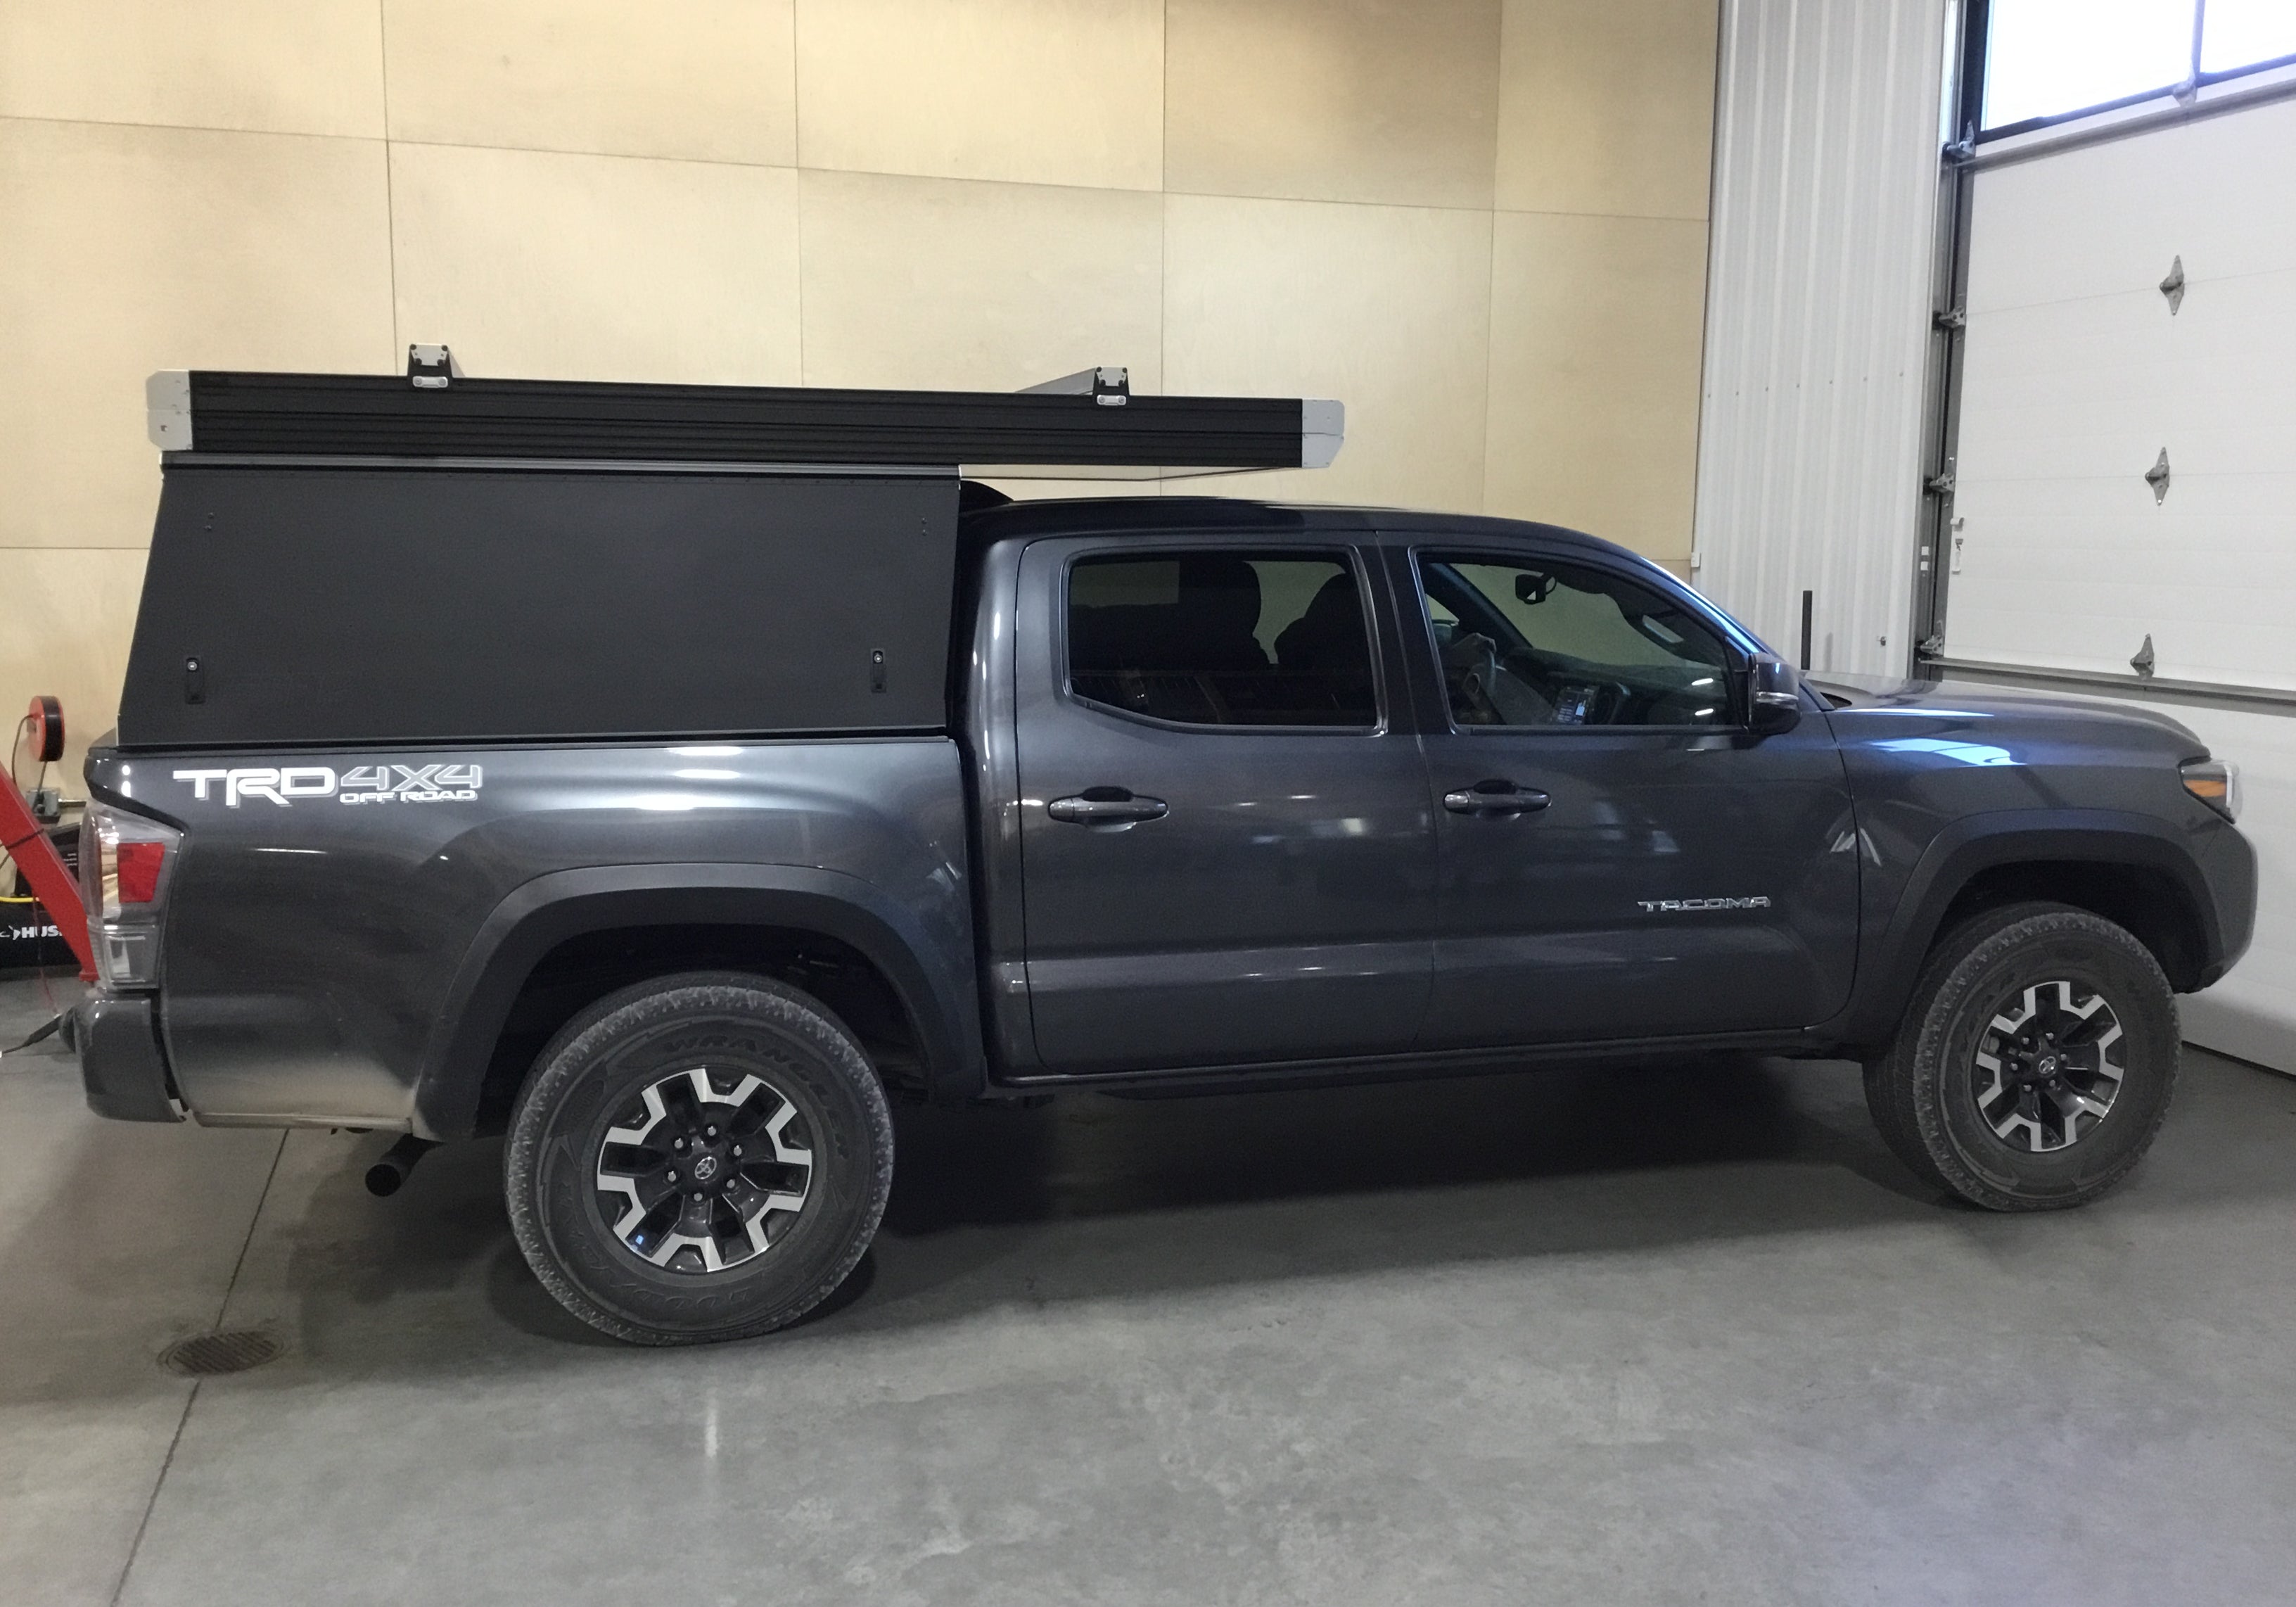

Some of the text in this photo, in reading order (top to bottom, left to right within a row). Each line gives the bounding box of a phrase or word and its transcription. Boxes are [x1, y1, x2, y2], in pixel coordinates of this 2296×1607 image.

[173, 764, 483, 808] TRD 4X4
[340, 789, 478, 804] OFF ROAD
[1637, 896, 1771, 913] TACOMA
[21, 925, 63, 939] HUS
